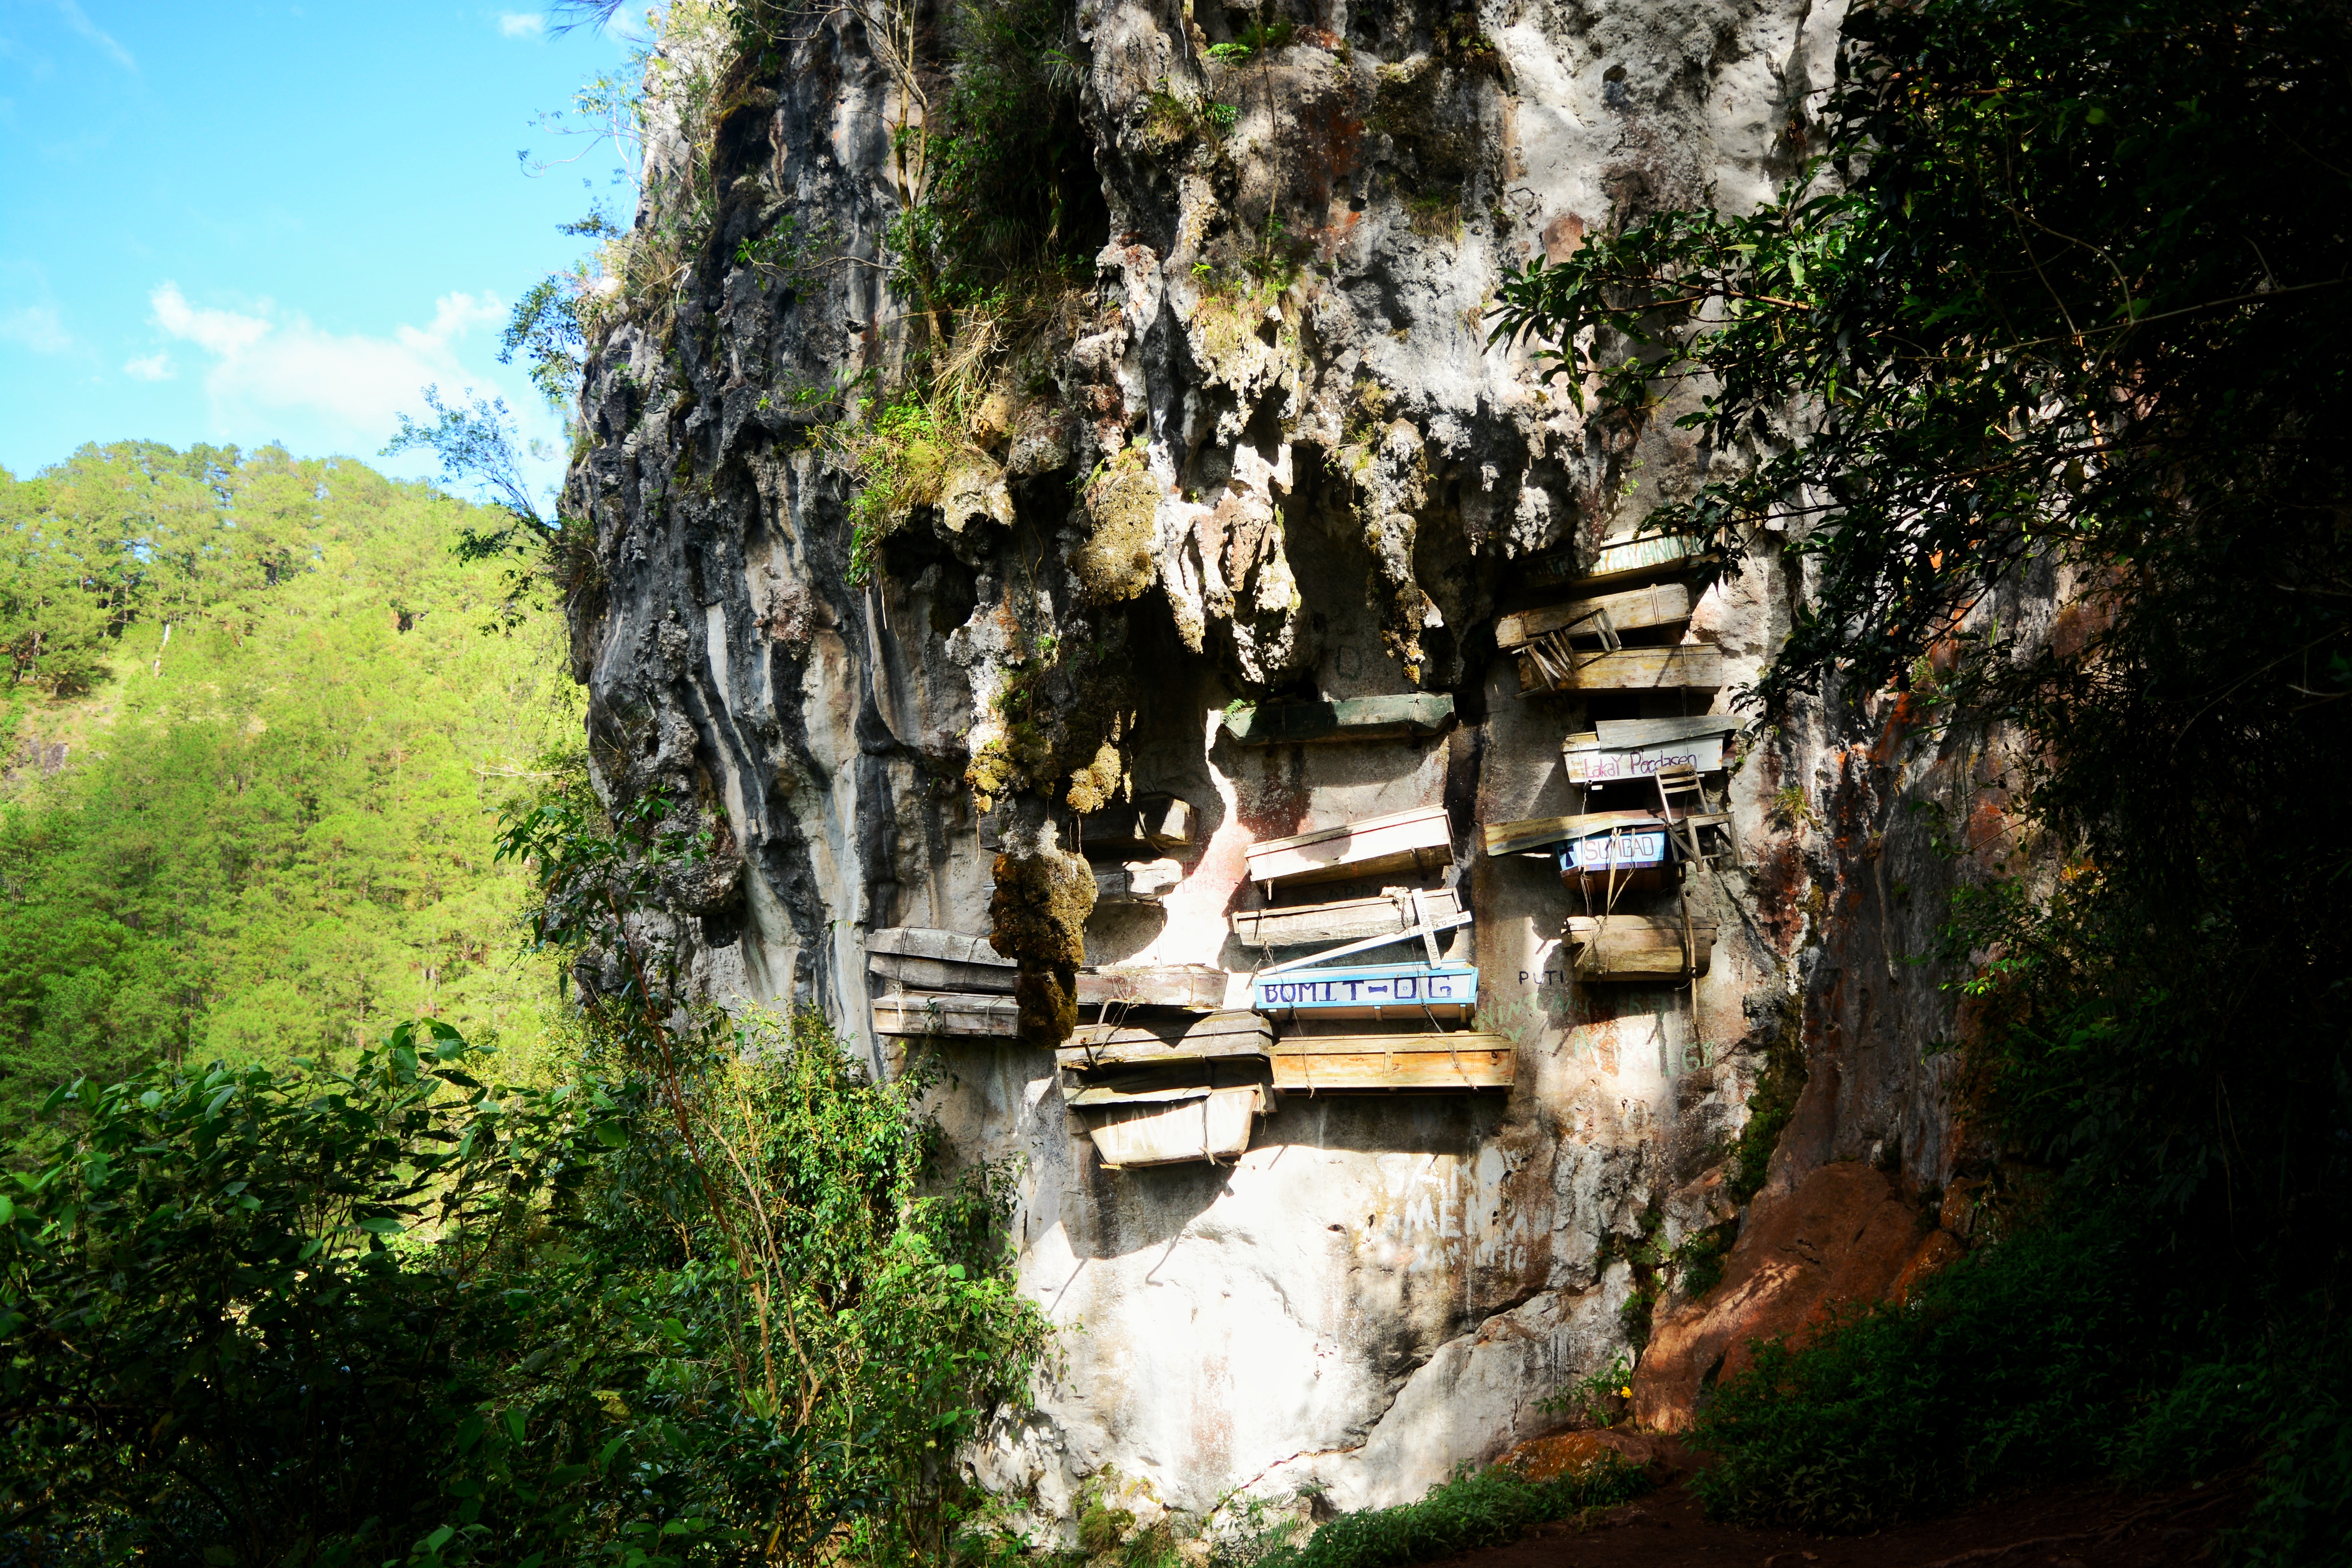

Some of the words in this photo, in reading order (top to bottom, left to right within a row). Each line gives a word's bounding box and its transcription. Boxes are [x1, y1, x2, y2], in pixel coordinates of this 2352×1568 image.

[1427, 939, 1439, 960] CALPI
[1519, 970, 1564, 985] PUTI
[1264, 975, 1452, 1003] BOMIT-OG
